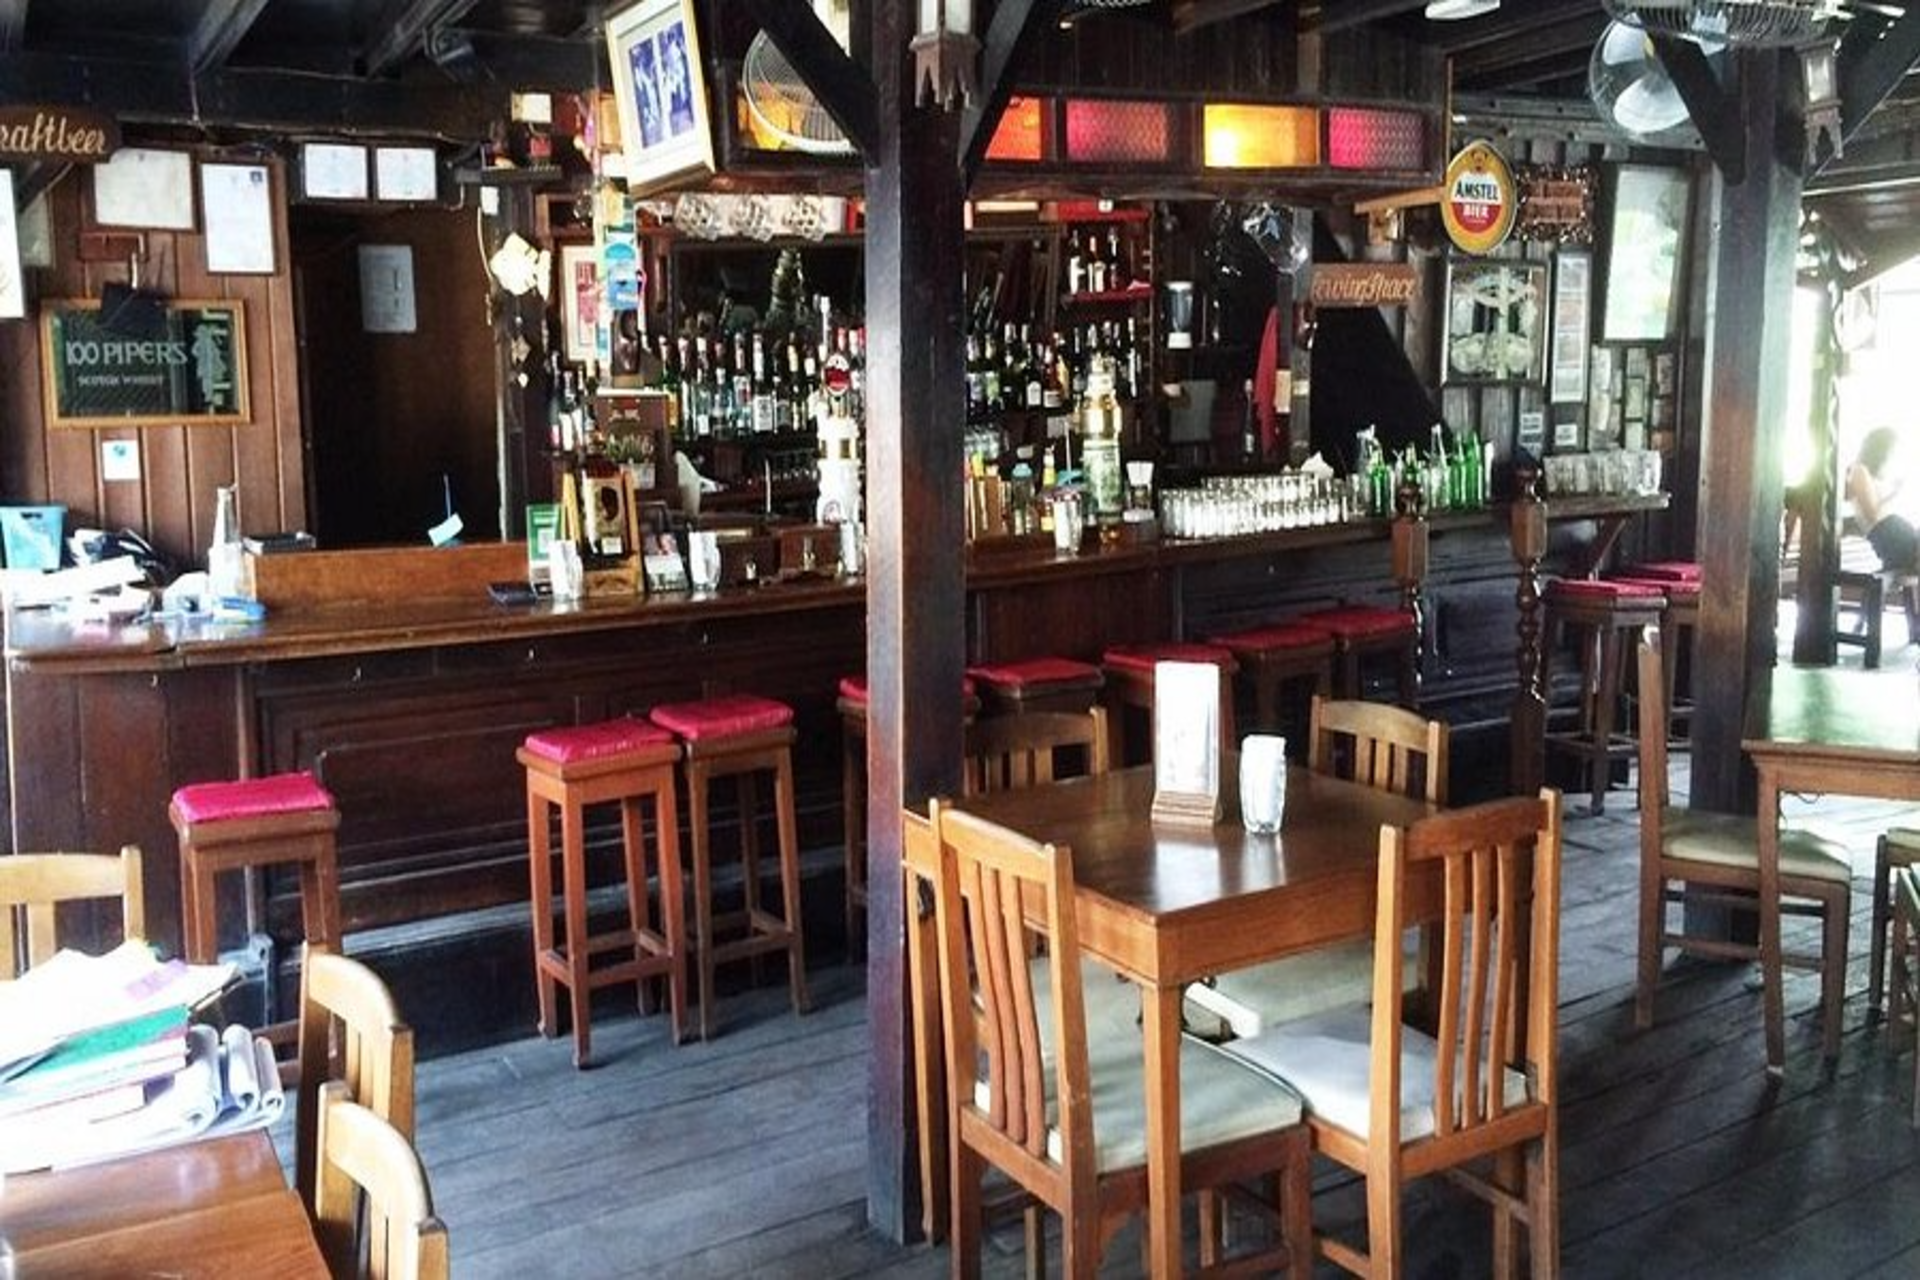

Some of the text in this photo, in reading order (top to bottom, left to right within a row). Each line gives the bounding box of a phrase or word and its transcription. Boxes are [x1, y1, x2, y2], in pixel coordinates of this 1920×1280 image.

[1455, 180, 1498, 201] AMSTEL
[1463, 203, 1489, 218] BIER
[66, 340, 188, 365] 100 PIPERS
